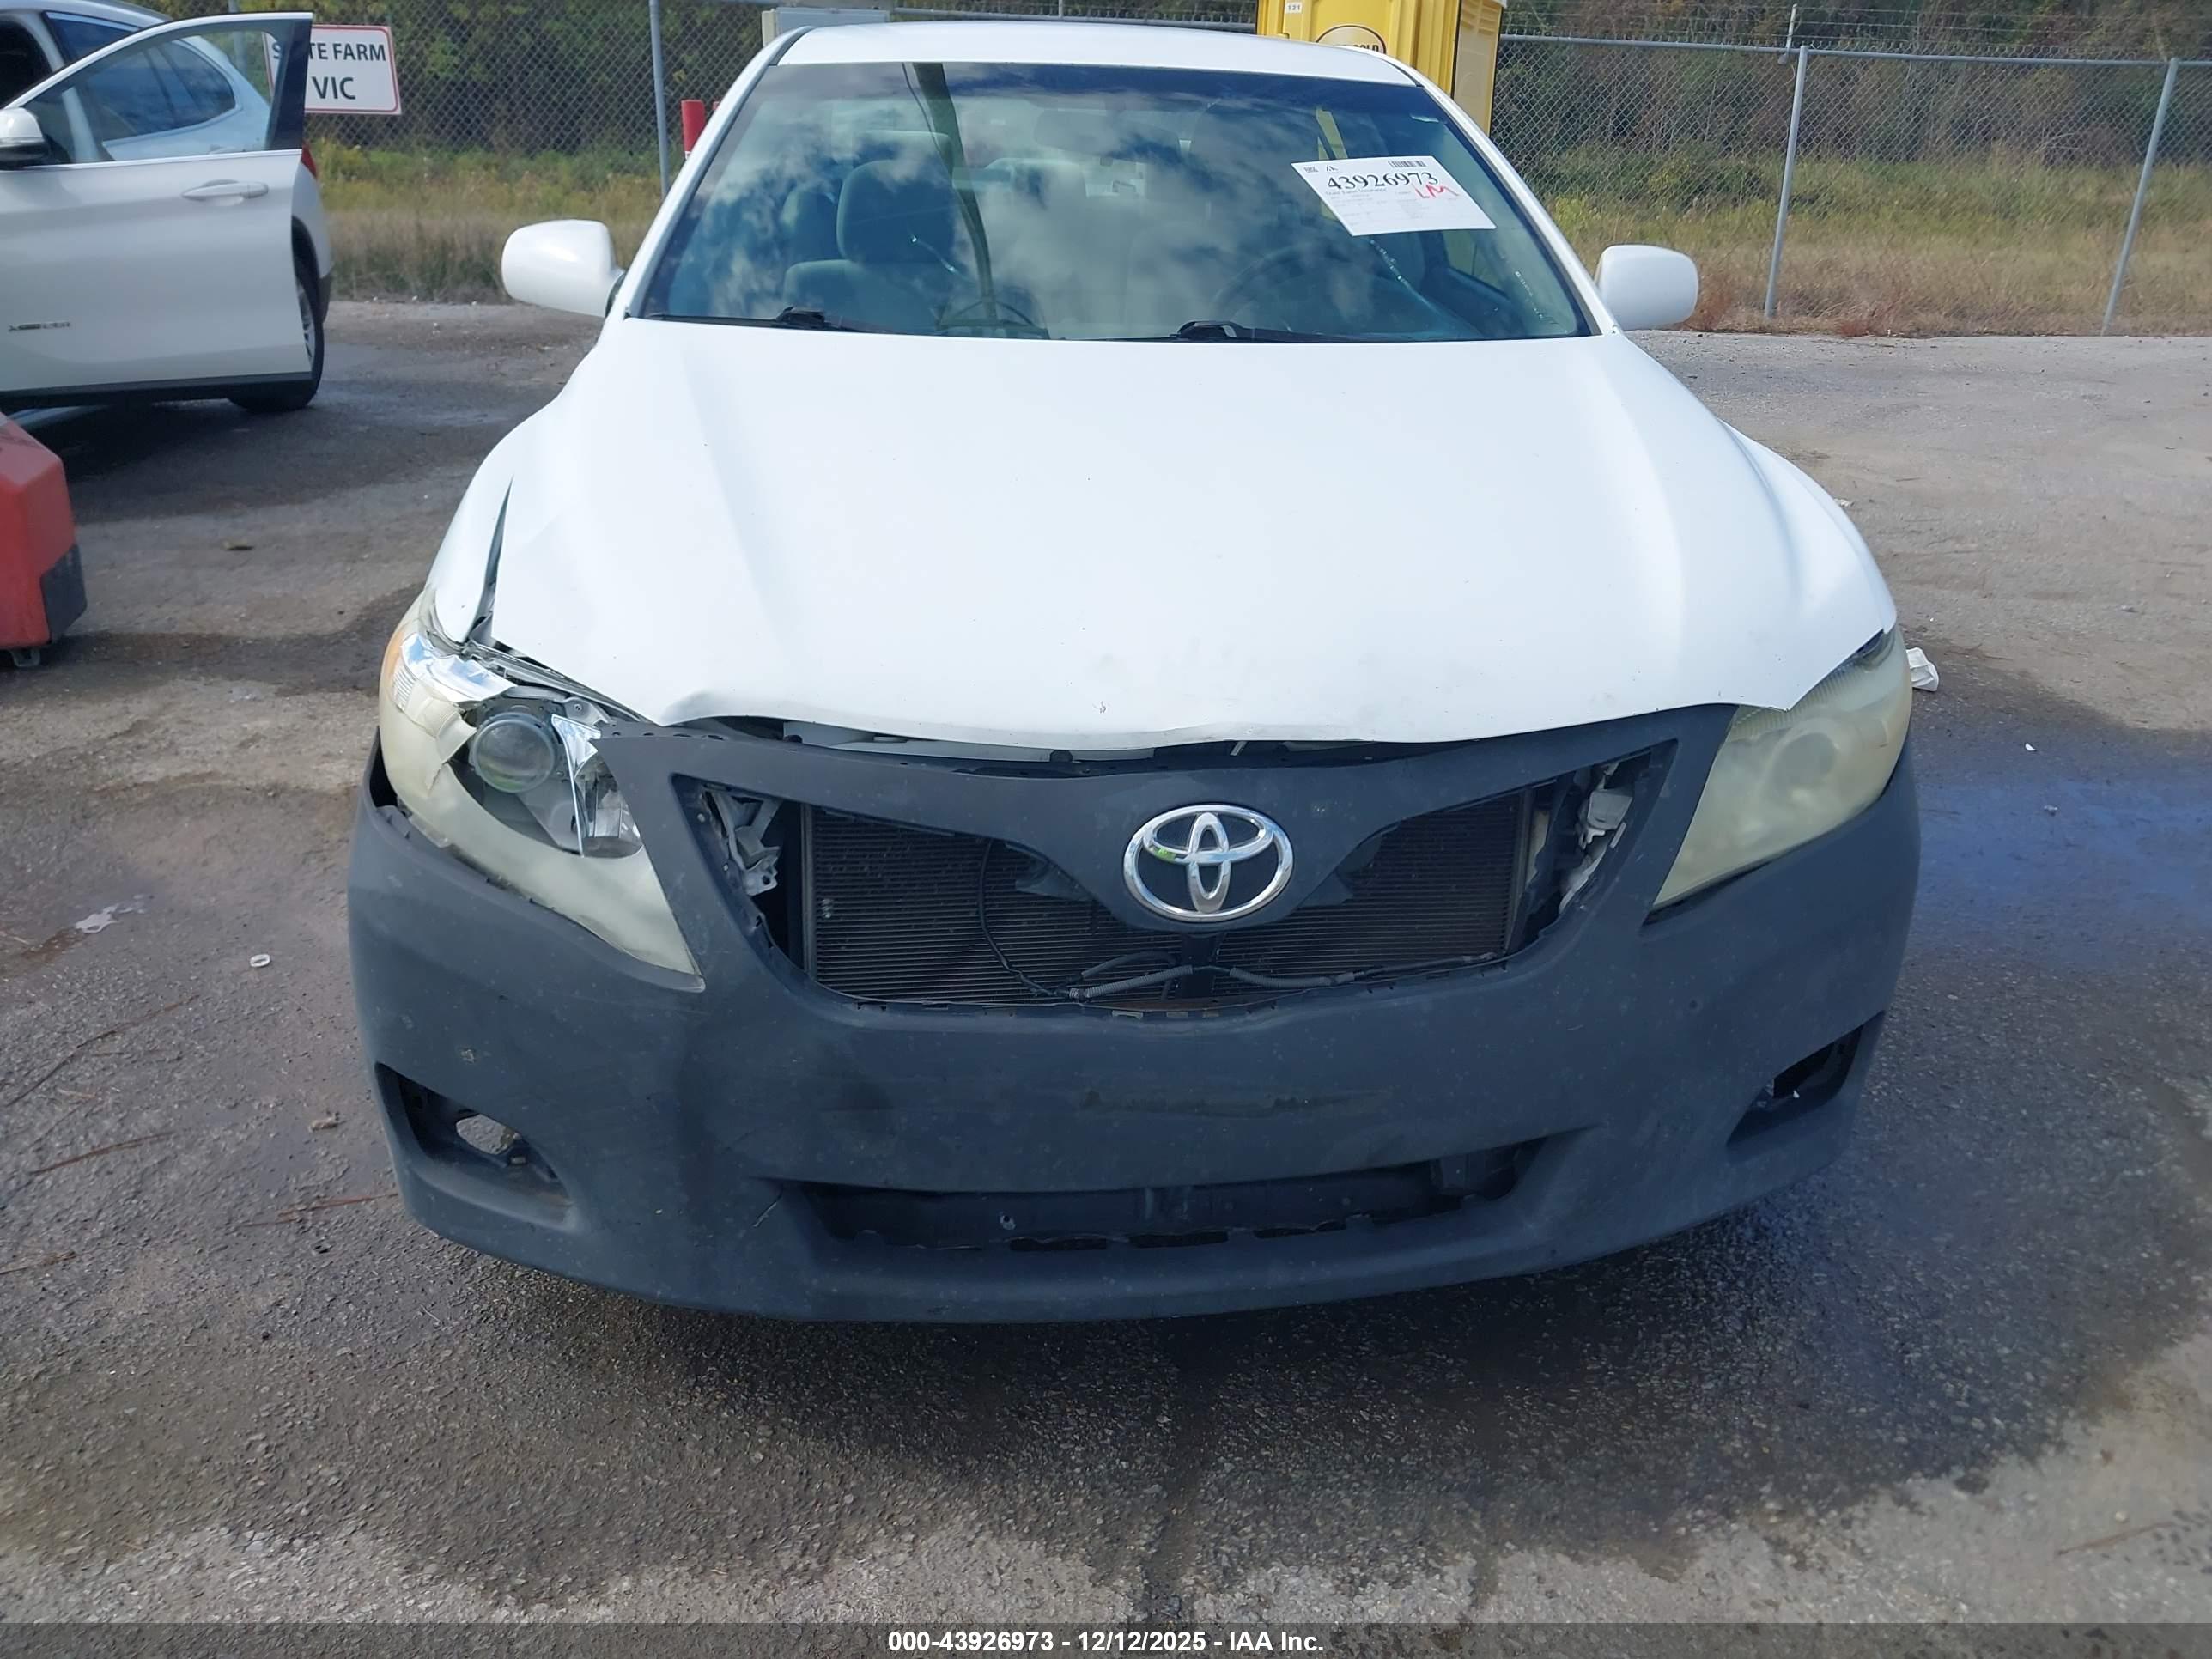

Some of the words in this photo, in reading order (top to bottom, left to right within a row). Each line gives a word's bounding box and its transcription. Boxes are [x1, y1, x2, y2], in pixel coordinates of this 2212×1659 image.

[272, 42, 328, 60] STE
[333, 43, 386, 61] FARM
[312, 76, 356, 100] VIC
[1328, 172, 1438, 190] 43926973
